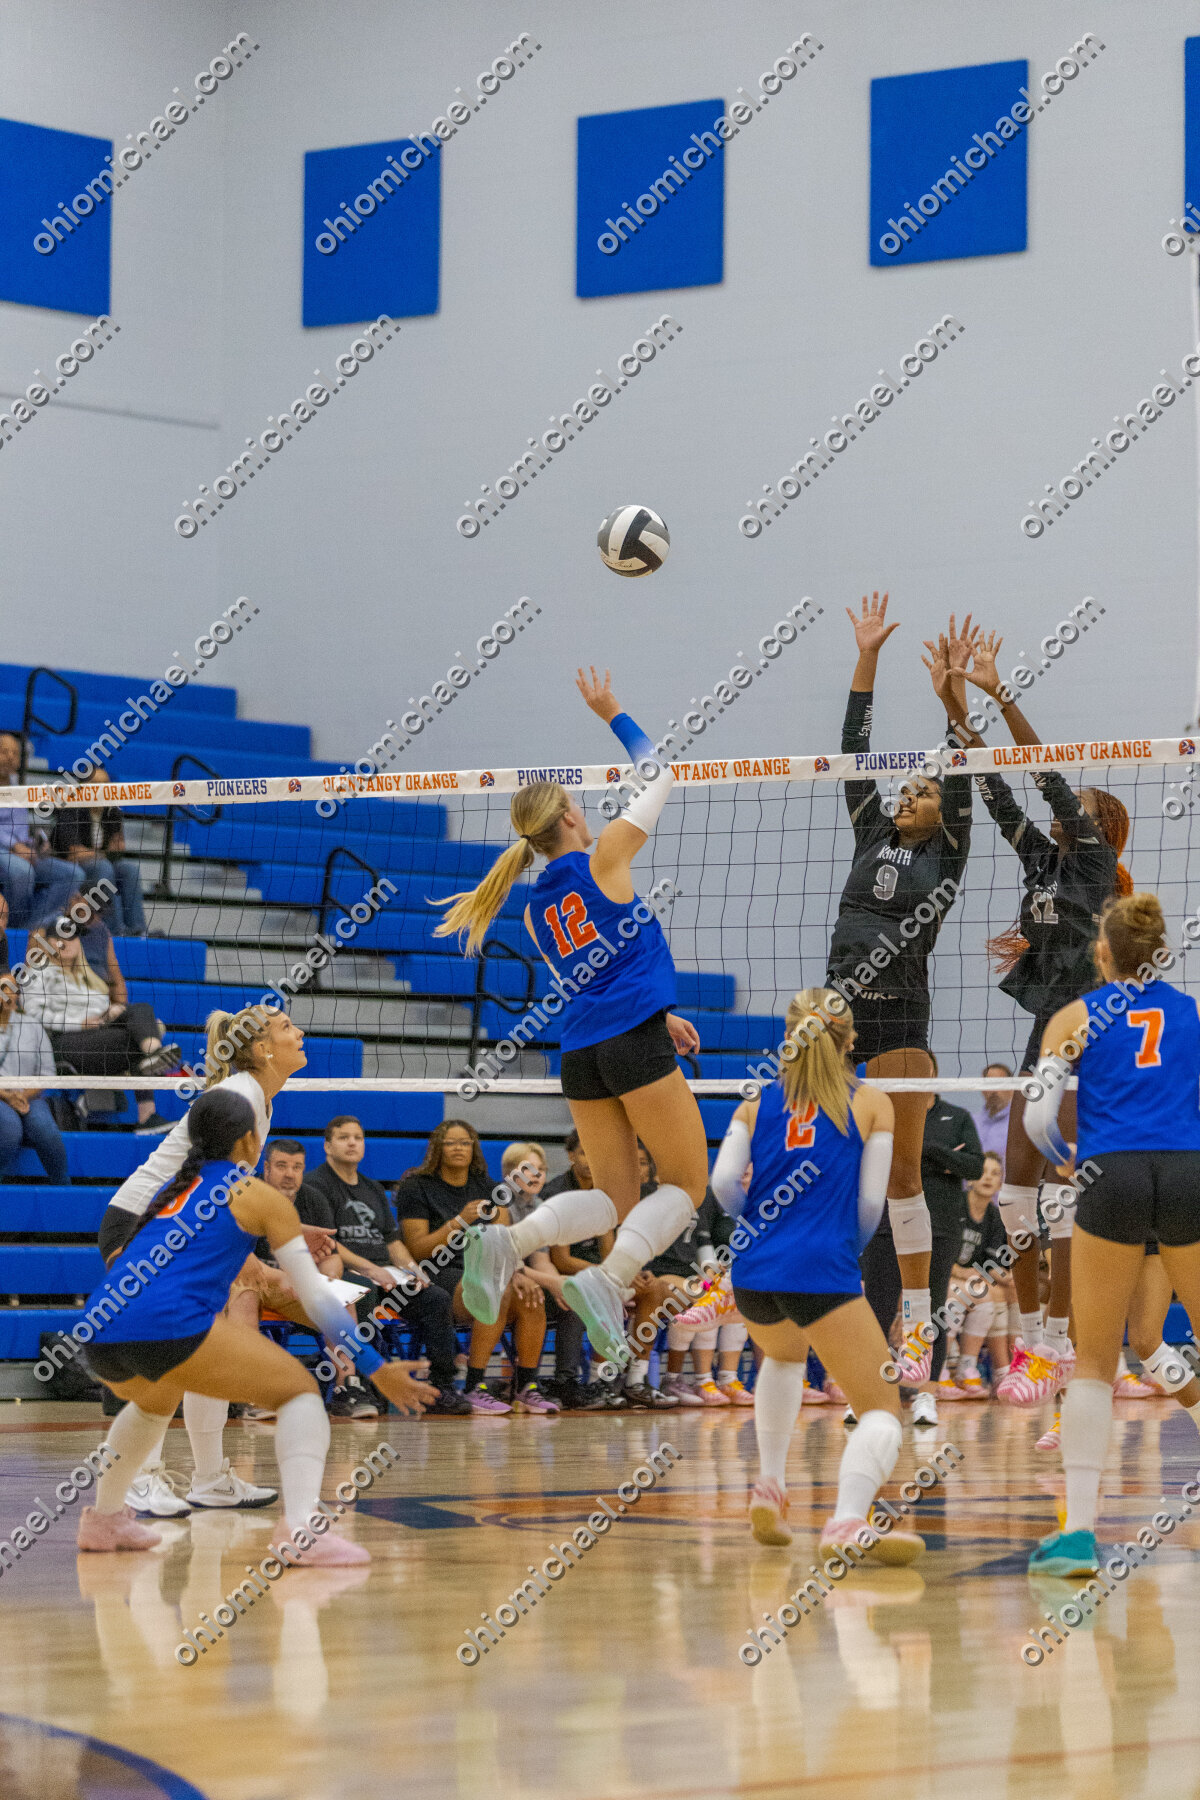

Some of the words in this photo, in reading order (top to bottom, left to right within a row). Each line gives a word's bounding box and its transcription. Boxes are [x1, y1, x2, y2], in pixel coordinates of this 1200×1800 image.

[855, 752, 926, 770] PIONEERS
[993, 743, 1086, 765] OLENTANGY
[1090, 741, 1152, 760] ORANGE
[517, 769, 582, 786] PIONEERS
[670, 761, 728, 781] NTANGY
[733, 758, 790, 777] ORANGE
[103, 784, 153, 801] ORANGE
[207, 779, 267, 796] PIONEERS
[323, 775, 402, 792] OLENTANGY
[405, 773, 458, 790] ORANGE
[873, 864, 899, 900] 9
[544, 891, 600, 959] 12
[1126, 1008, 1165, 1068] 7
[785, 1098, 818, 1151] 2
